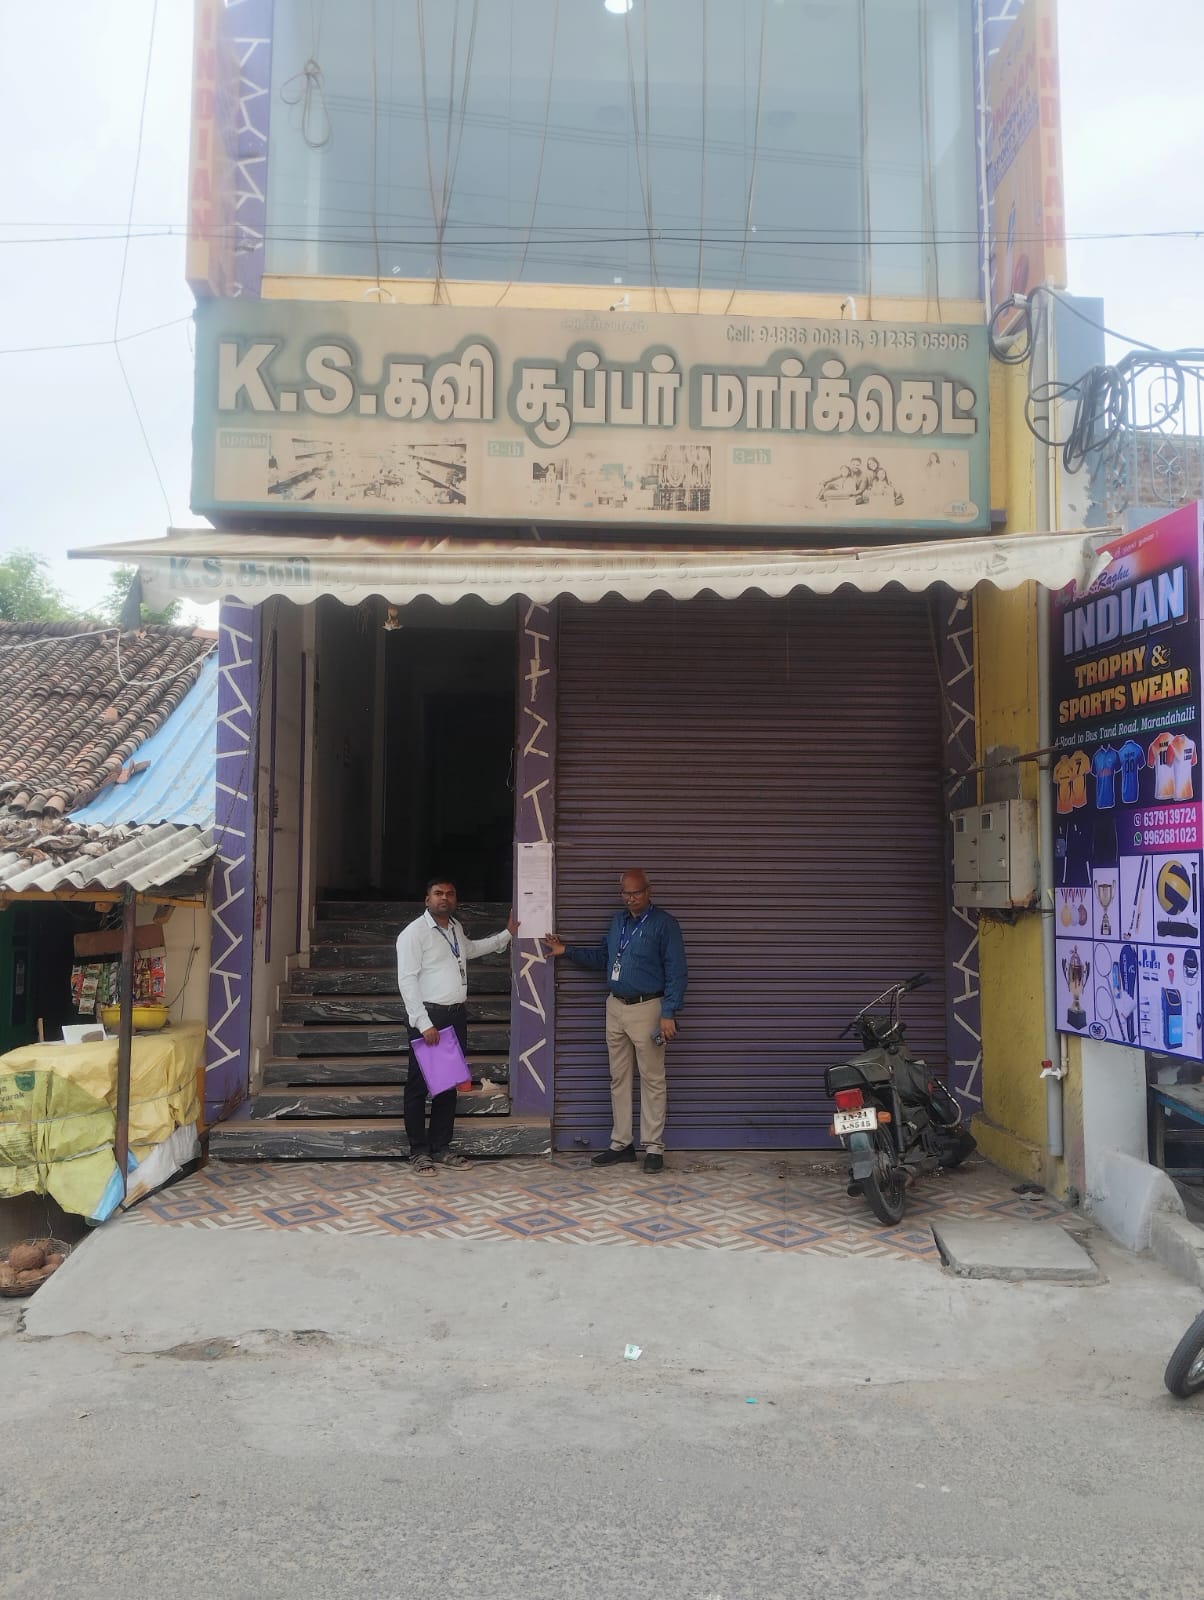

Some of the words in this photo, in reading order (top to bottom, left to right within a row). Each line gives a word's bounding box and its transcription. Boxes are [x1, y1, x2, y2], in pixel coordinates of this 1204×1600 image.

[726, 324, 755, 343] Cell:
[920, 332, 969, 351] 05906
[516, 350, 682, 446] சூப்பர்
[700, 357, 977, 435] மார்க்கெட்
[1063, 566, 1185, 656] INDIAN
[1074, 645, 1147, 689] TROPHY
[1151, 644, 1170, 667] &
[1059, 686, 1126, 724] SPORTS
[1131, 667, 1190, 706] WEAR
[1085, 731, 1098, 742] Bus
[1141, 706, 1196, 731] Marandahalli
[1143, 807, 1196, 827] 6379139724
[1143, 827, 1197, 845] 9962681023
